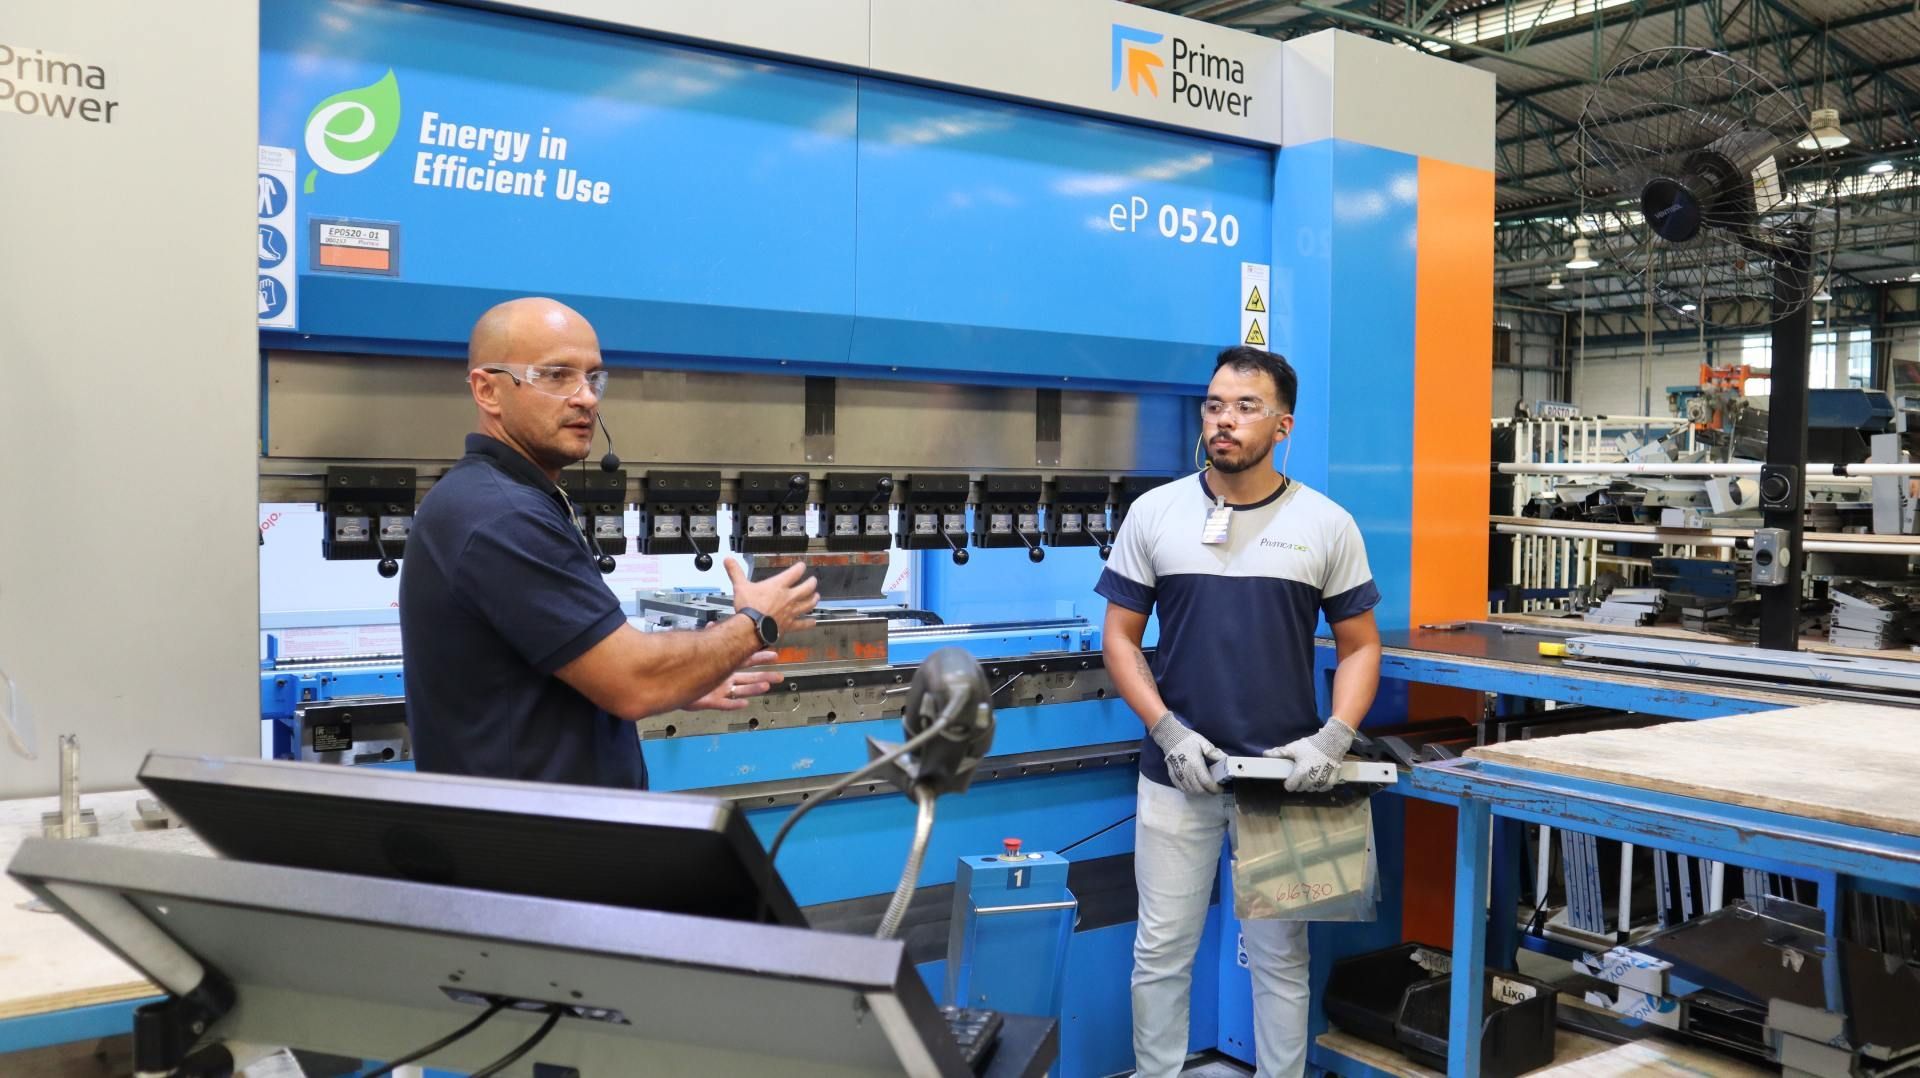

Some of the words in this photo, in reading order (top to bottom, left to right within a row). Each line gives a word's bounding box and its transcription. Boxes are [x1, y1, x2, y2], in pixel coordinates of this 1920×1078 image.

[0, 44, 106, 90] Prima
[1172, 37, 1244, 84] Prima
[0, 78, 119, 124] Power
[1172, 71, 1252, 118] Power
[418, 111, 531, 163] Energy
[538, 127, 567, 161] in
[413, 151, 547, 198] Efficient
[555, 168, 611, 205] Use
[368, 231, 379, 240] 01
[1108, 195, 1149, 232] eP
[1158, 204, 1240, 247] 0520
[1013, 868, 1023, 887] 1
[1275, 883, 1334, 902] 616780
